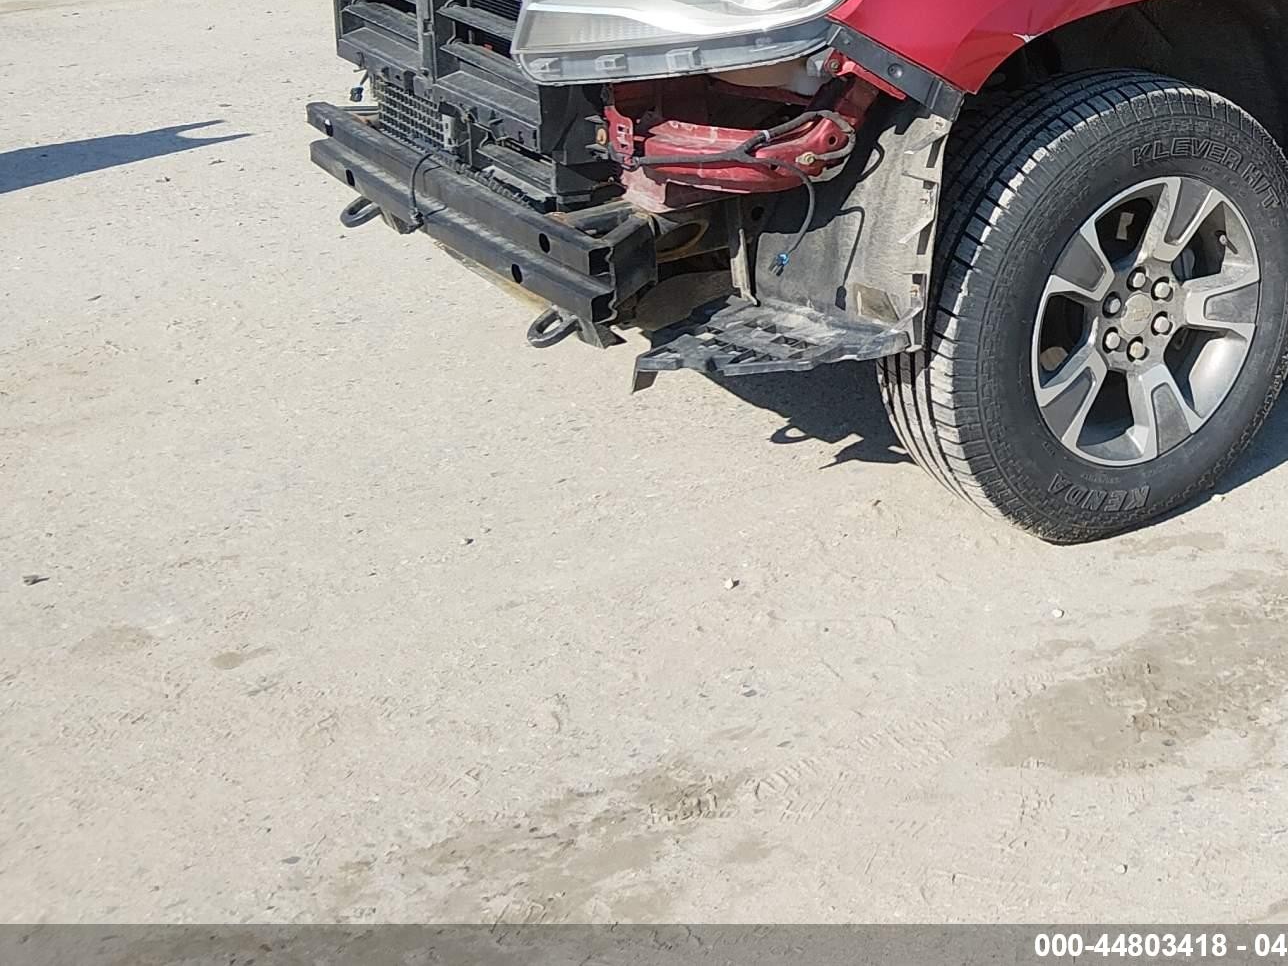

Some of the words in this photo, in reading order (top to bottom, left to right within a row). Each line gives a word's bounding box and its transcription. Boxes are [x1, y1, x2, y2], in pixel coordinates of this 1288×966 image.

[1132, 137, 1242, 171] KLEVER
[1240, 162, 1281, 210] H/T
[1047, 473, 1151, 512] KENDA
